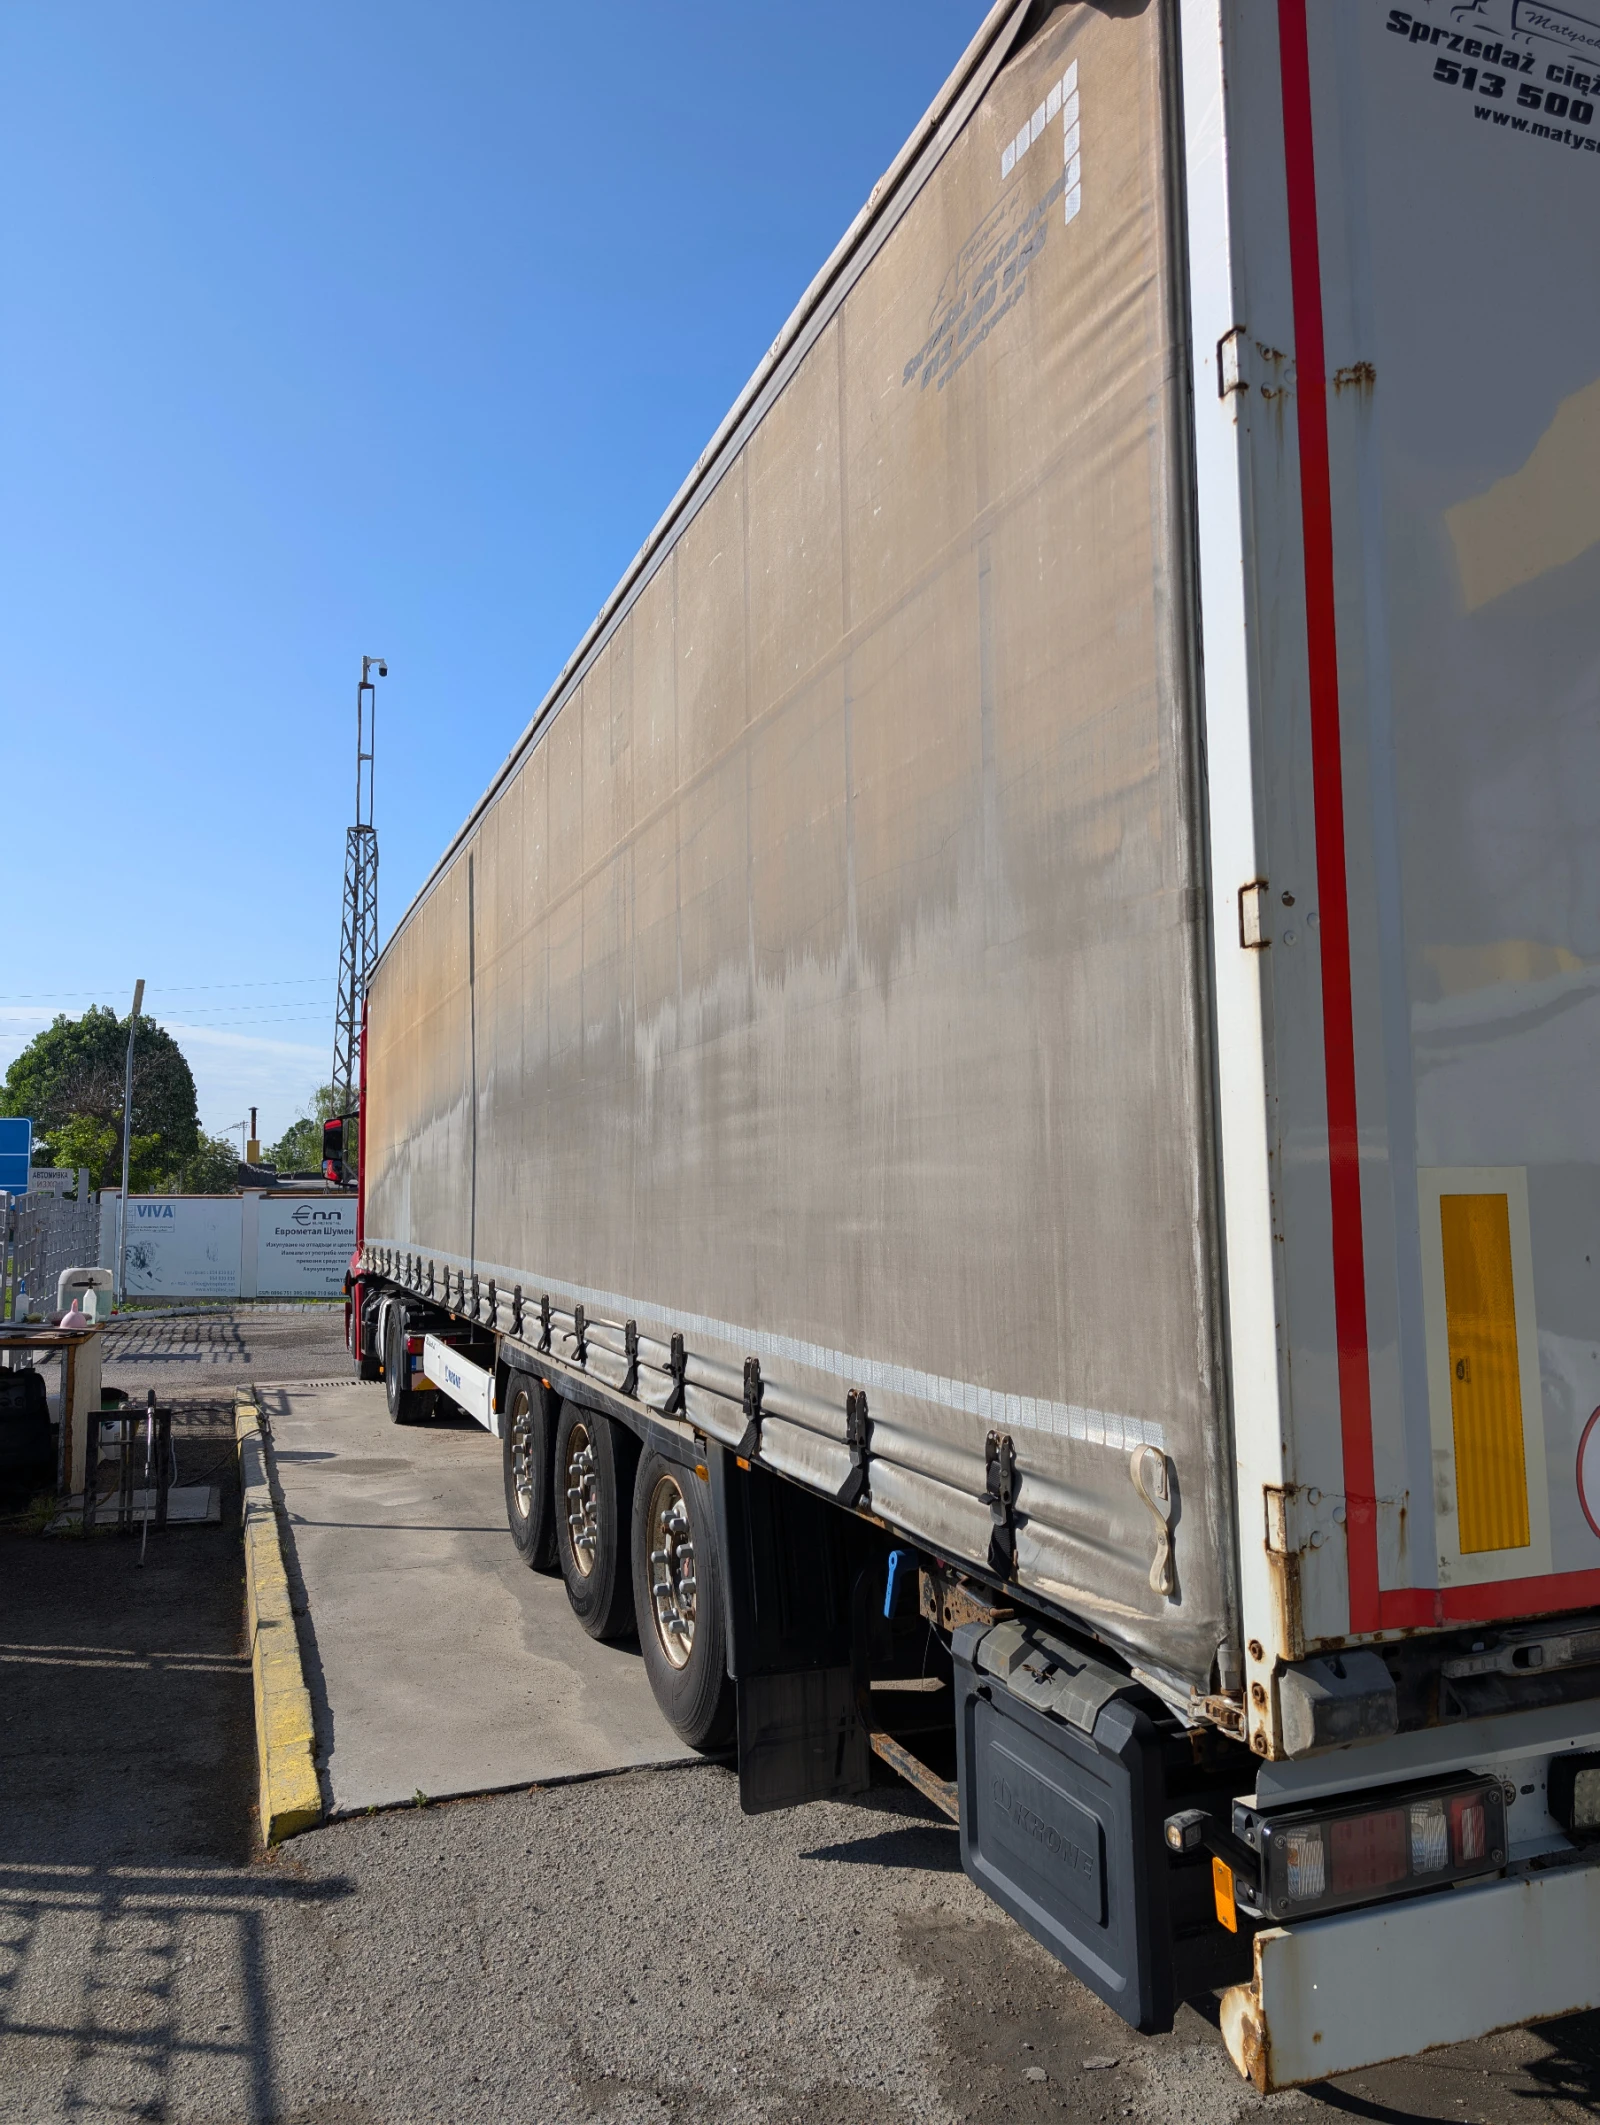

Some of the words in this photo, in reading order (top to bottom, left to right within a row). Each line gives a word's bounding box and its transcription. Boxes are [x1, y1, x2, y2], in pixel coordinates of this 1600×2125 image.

[1386, 9, 1536, 75] Sprzedaż
[1432, 56, 1506, 99] 513
[1516, 83, 1594, 126] 500
[136, 1204, 174, 1218] VIVA
[274, 1227, 322, 1237] Еврометал
[323, 1227, 354, 1237] Шумен
[1013, 1799, 1094, 1882] KRONE
